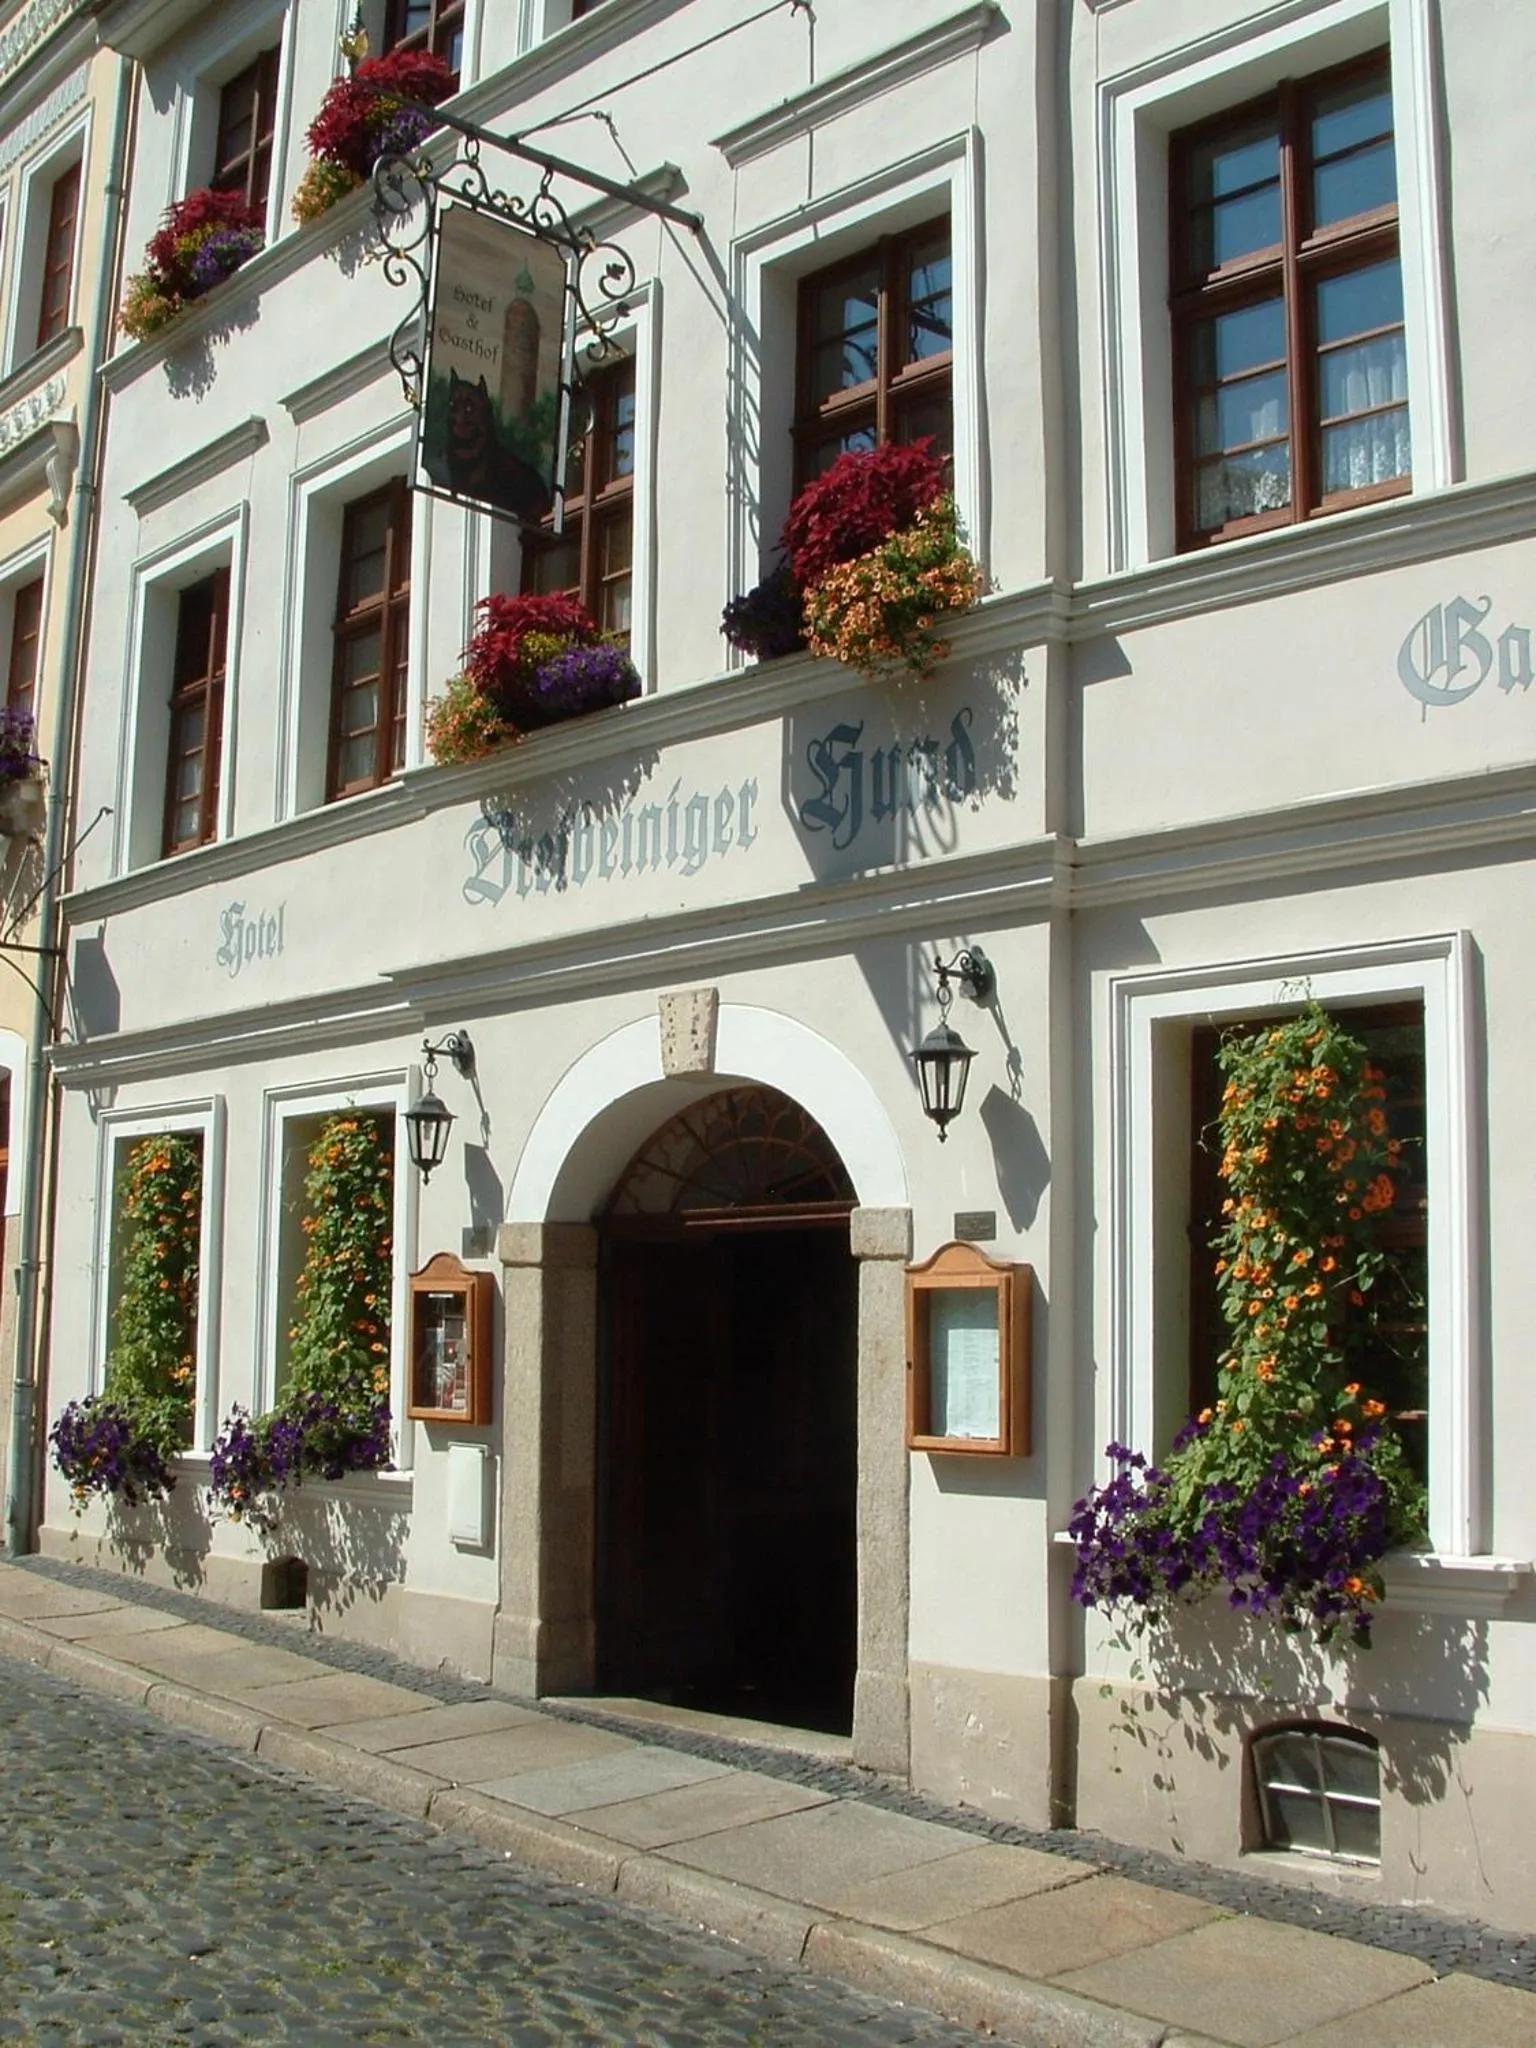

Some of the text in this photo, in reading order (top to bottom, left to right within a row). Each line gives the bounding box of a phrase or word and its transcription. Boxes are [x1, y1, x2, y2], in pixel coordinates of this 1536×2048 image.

[453, 285, 495, 313] Hotel
[466, 314, 479, 331] &
[439, 326, 499, 365] Gasthof
[463, 706, 977, 907] Dreibeiniger Hund
[216, 899, 286, 979] Hotel
